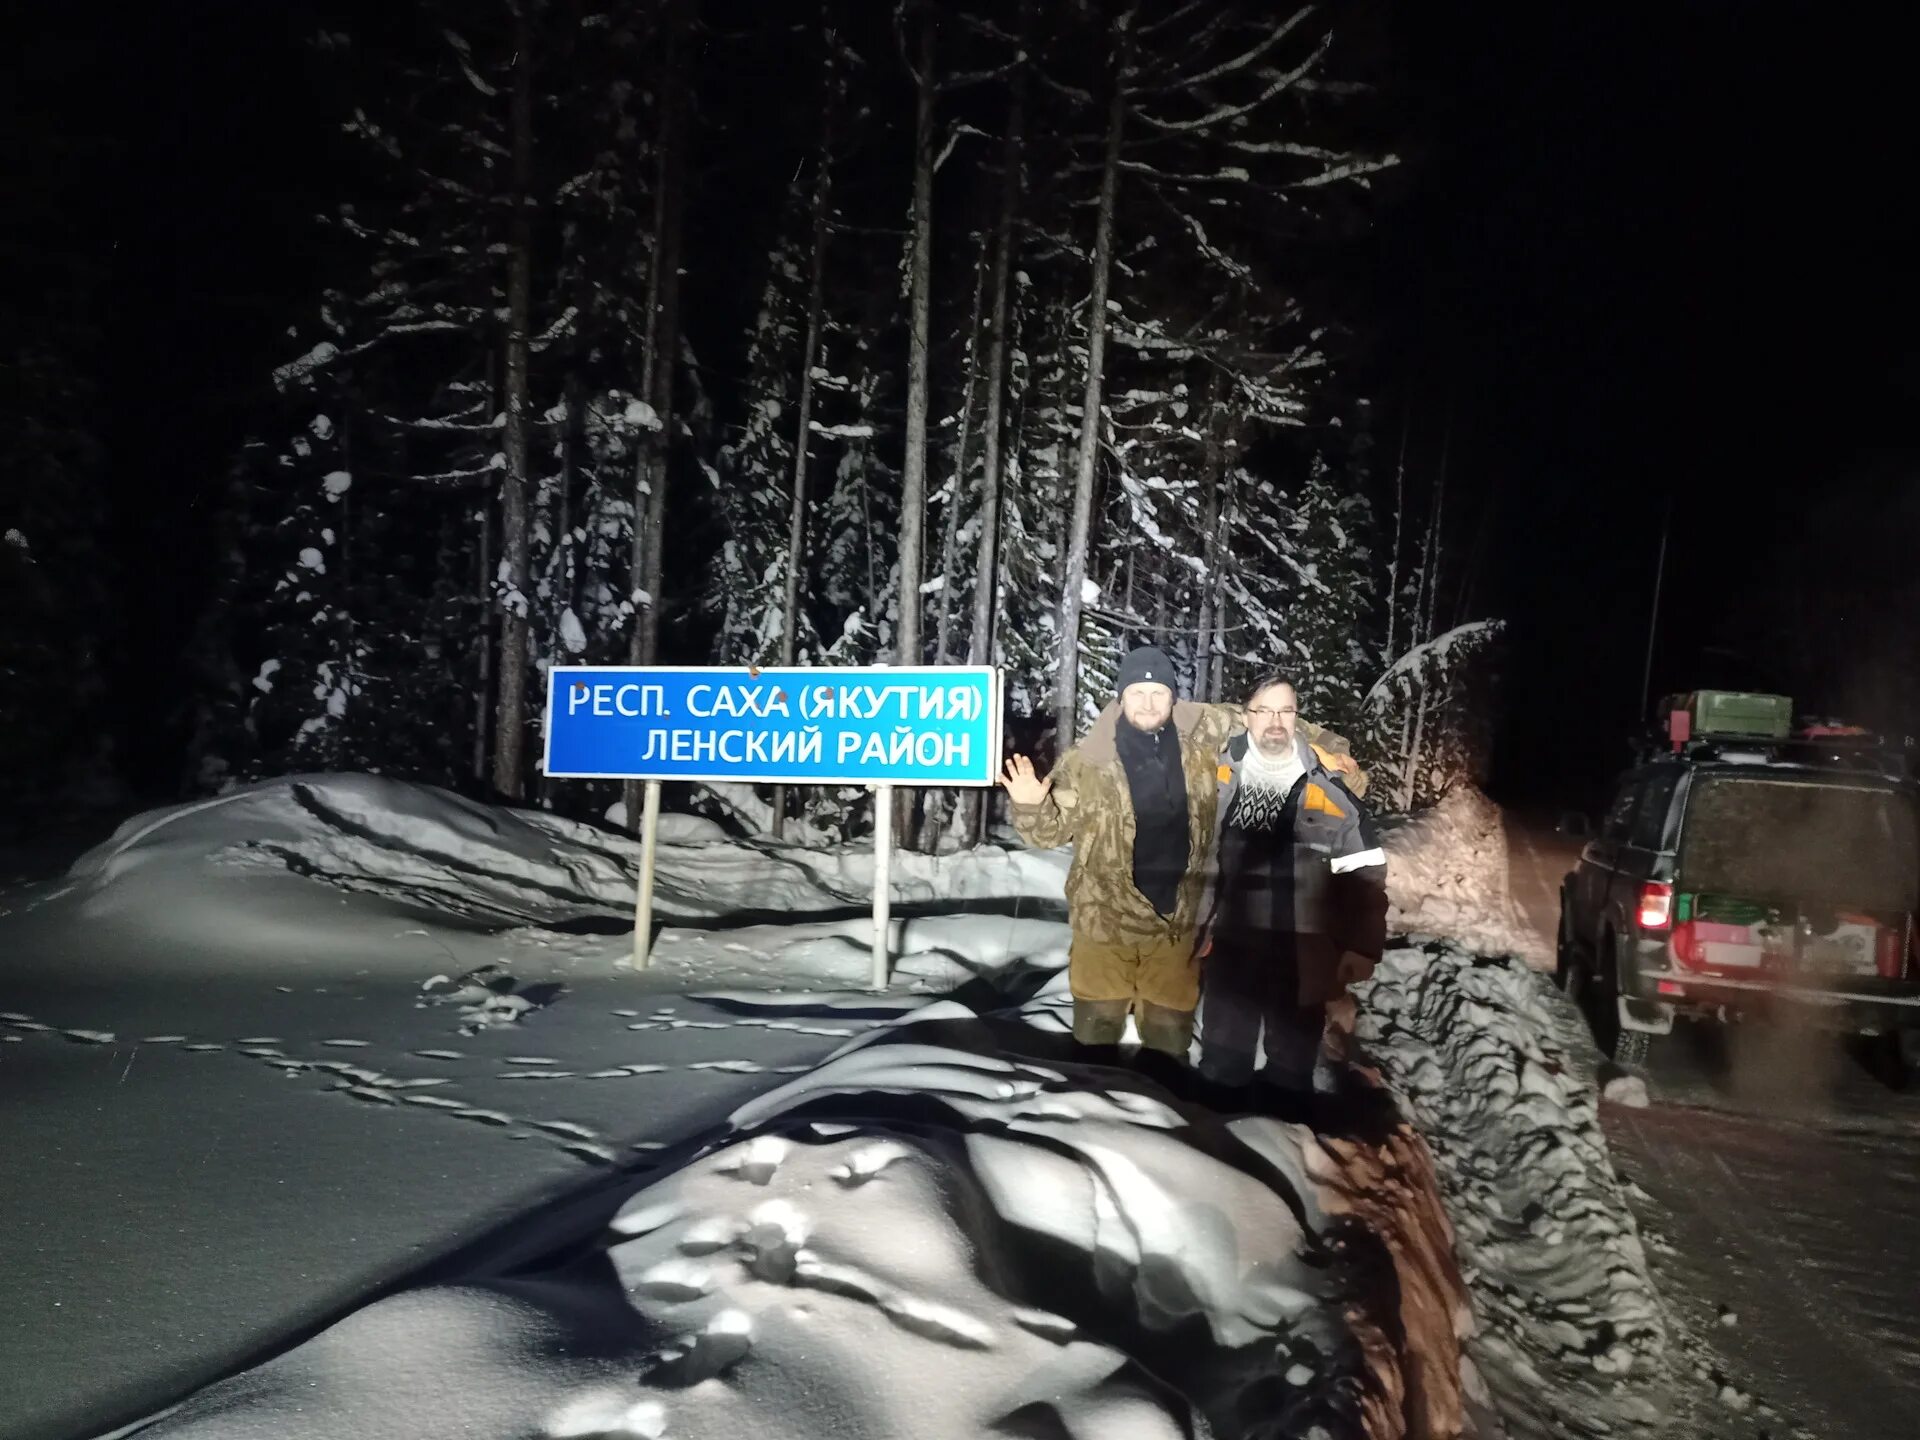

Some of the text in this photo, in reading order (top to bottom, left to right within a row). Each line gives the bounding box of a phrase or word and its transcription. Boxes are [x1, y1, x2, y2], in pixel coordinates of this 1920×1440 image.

[568, 684, 983, 722] РЕСП. САХА (ЯКУТИЯ)
[641, 726, 970, 766] ЛЕНСКИЙ РАЙОН
